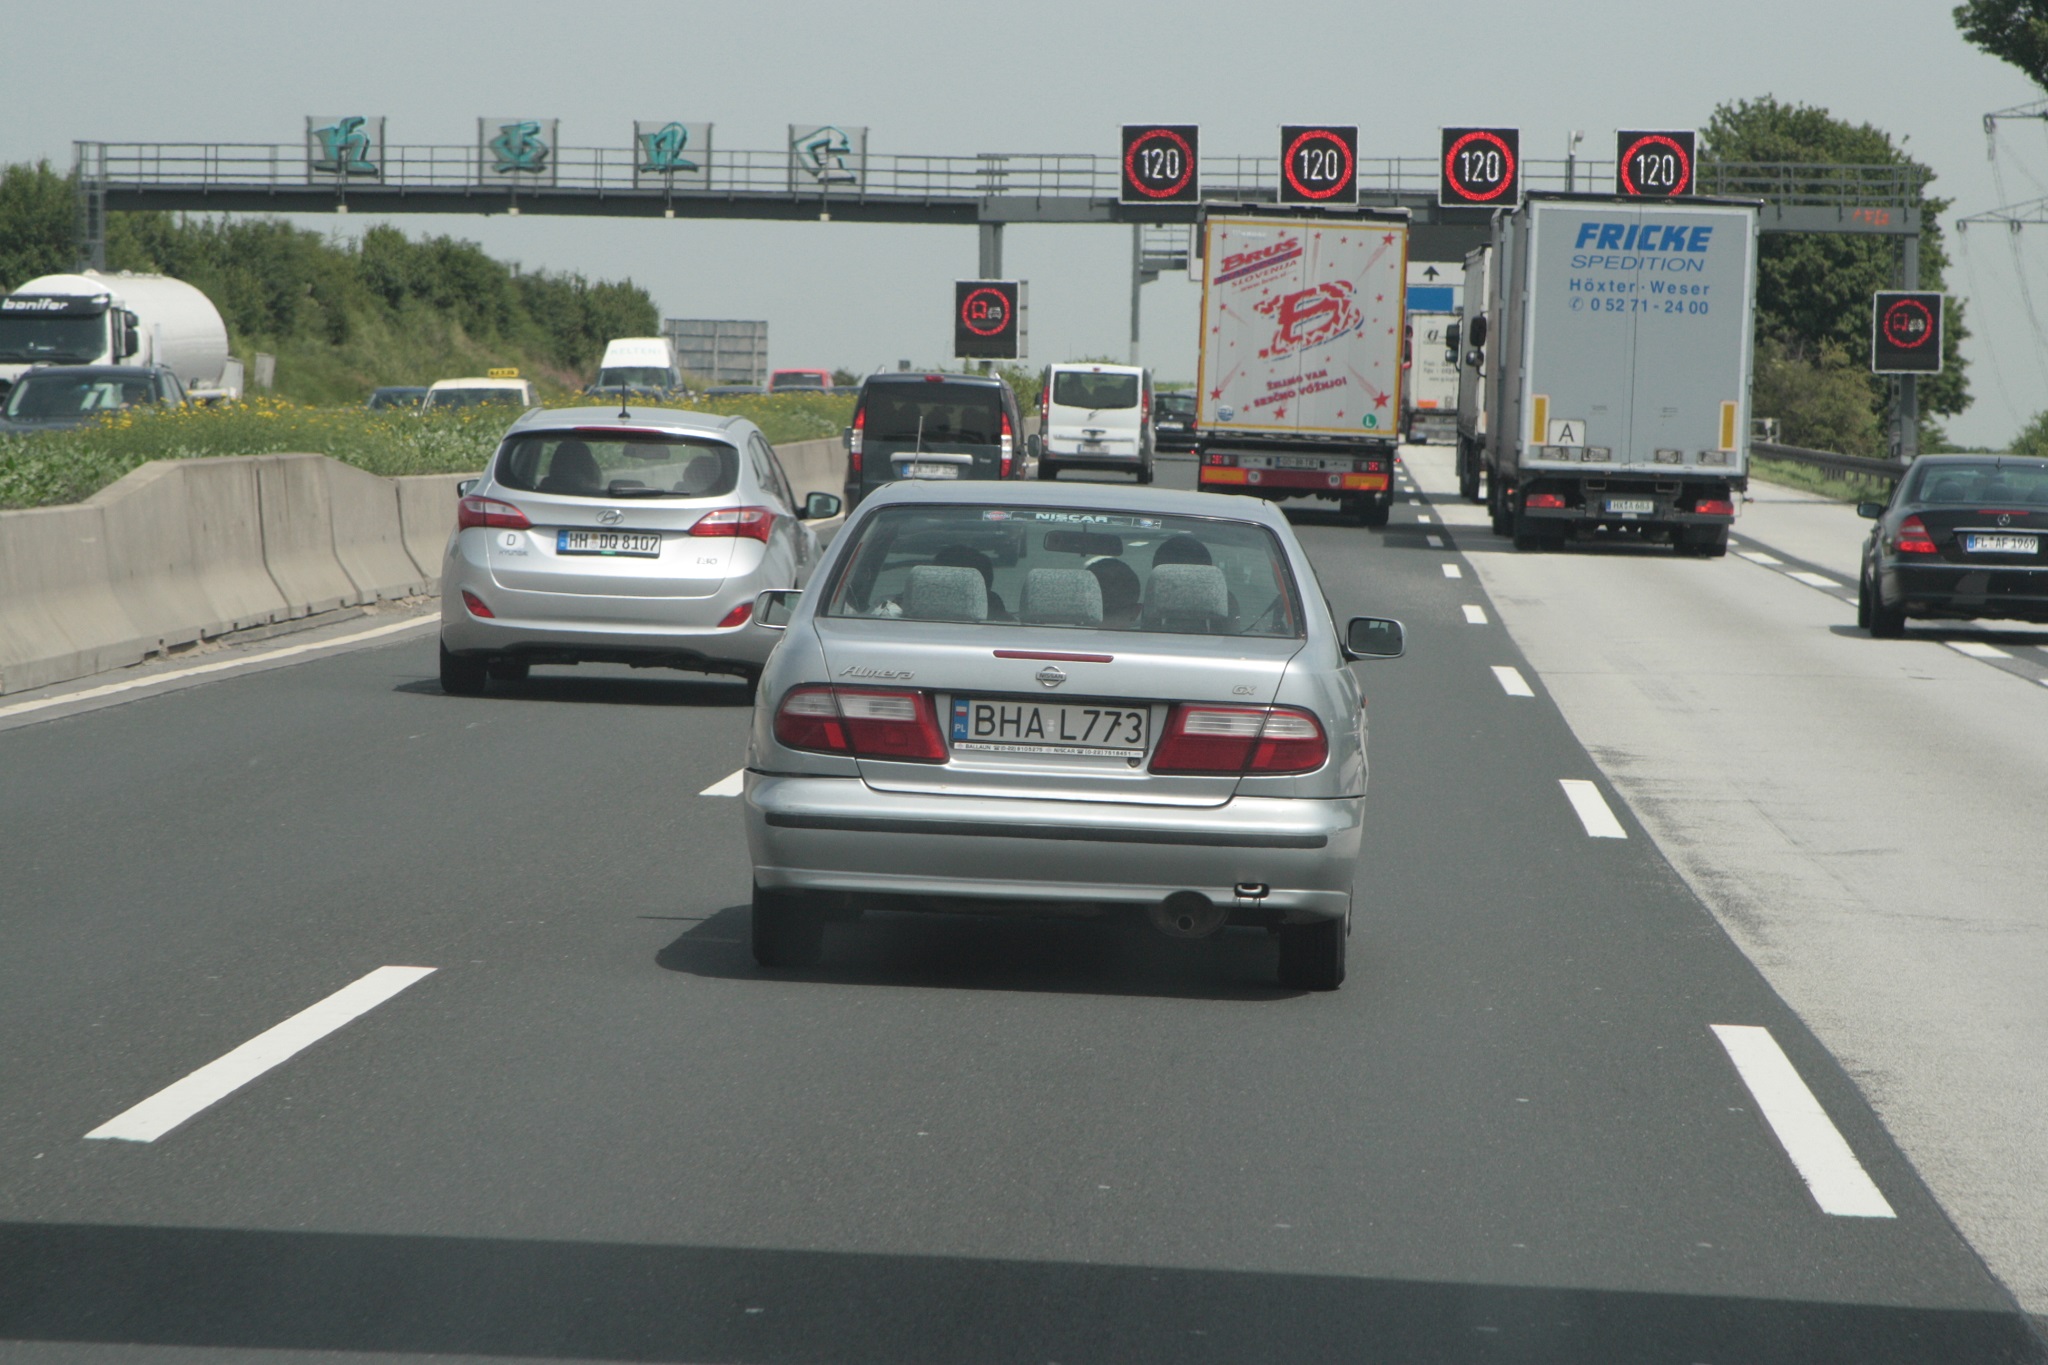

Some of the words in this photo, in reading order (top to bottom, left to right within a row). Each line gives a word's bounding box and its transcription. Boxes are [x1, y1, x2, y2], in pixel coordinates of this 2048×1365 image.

[1141, 148, 1179, 179] 120
[1299, 149, 1338, 180] 120
[1461, 150, 1500, 183] 120
[1636, 154, 1675, 186] 120
[1574, 222, 1713, 253] FRICKE
[1570, 254, 1705, 272] SPEDITION
[1231, 259, 1298, 288] SLOVENIJA
[1569, 277, 1636, 293] Höxter
[1650, 280, 1710, 295] Weser
[1558, 422, 1574, 443] A
[1035, 512, 1108, 524] NISCAR
[506, 533, 517, 546] D
[569, 532, 588, 549] HH
[622, 535, 659, 552] 8107
[1975, 536, 1988, 548] FL
[1995, 536, 2008, 548] AF
[2011, 537, 2036, 550] 1969
[839, 664, 915, 681] Almera
[1038, 672, 1064, 680] NISSAN
[1232, 684, 1256, 696] GX
[954, 723, 967, 733] PL
[974, 704, 1045, 740] BHA
[1060, 708, 1142, 744] L773
[1054, 747, 1076, 755] NISCAR
